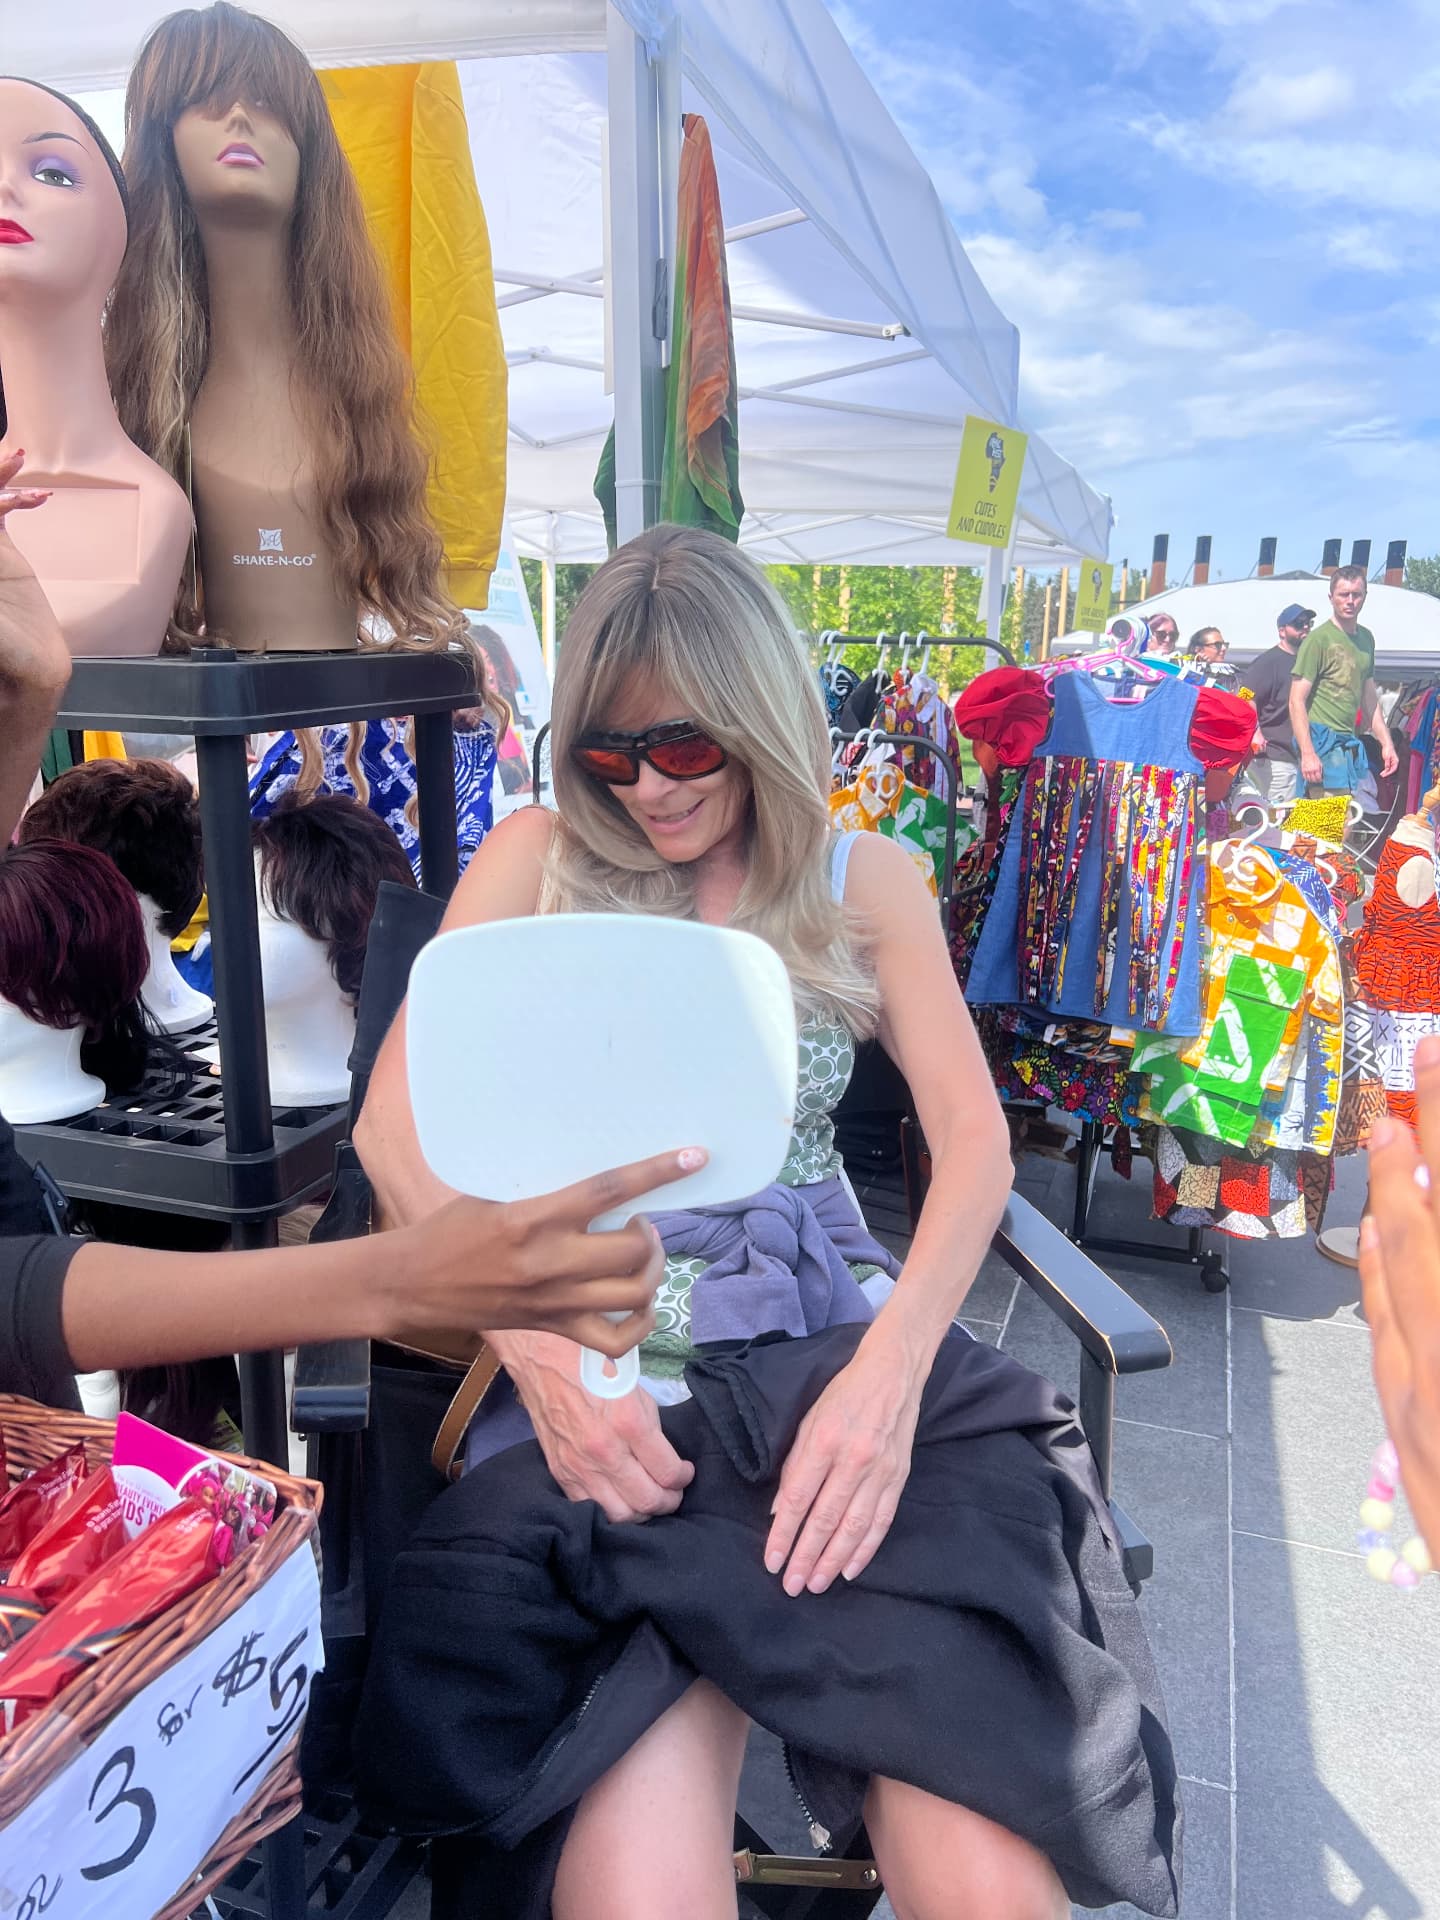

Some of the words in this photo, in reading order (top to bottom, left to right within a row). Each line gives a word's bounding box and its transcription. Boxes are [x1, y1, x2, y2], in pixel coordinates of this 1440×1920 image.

[974, 500, 998, 518] CUTES
[956, 516, 975, 533] AND
[974, 519, 1007, 539] CUDDLES
[232, 554, 314, 566] SHAKE-N-GO
[120, 1498, 145, 1527] IDS
[80, 1745, 157, 1881] 3
[156, 1683, 204, 1746] for
[211, 1627, 309, 1737] $5
